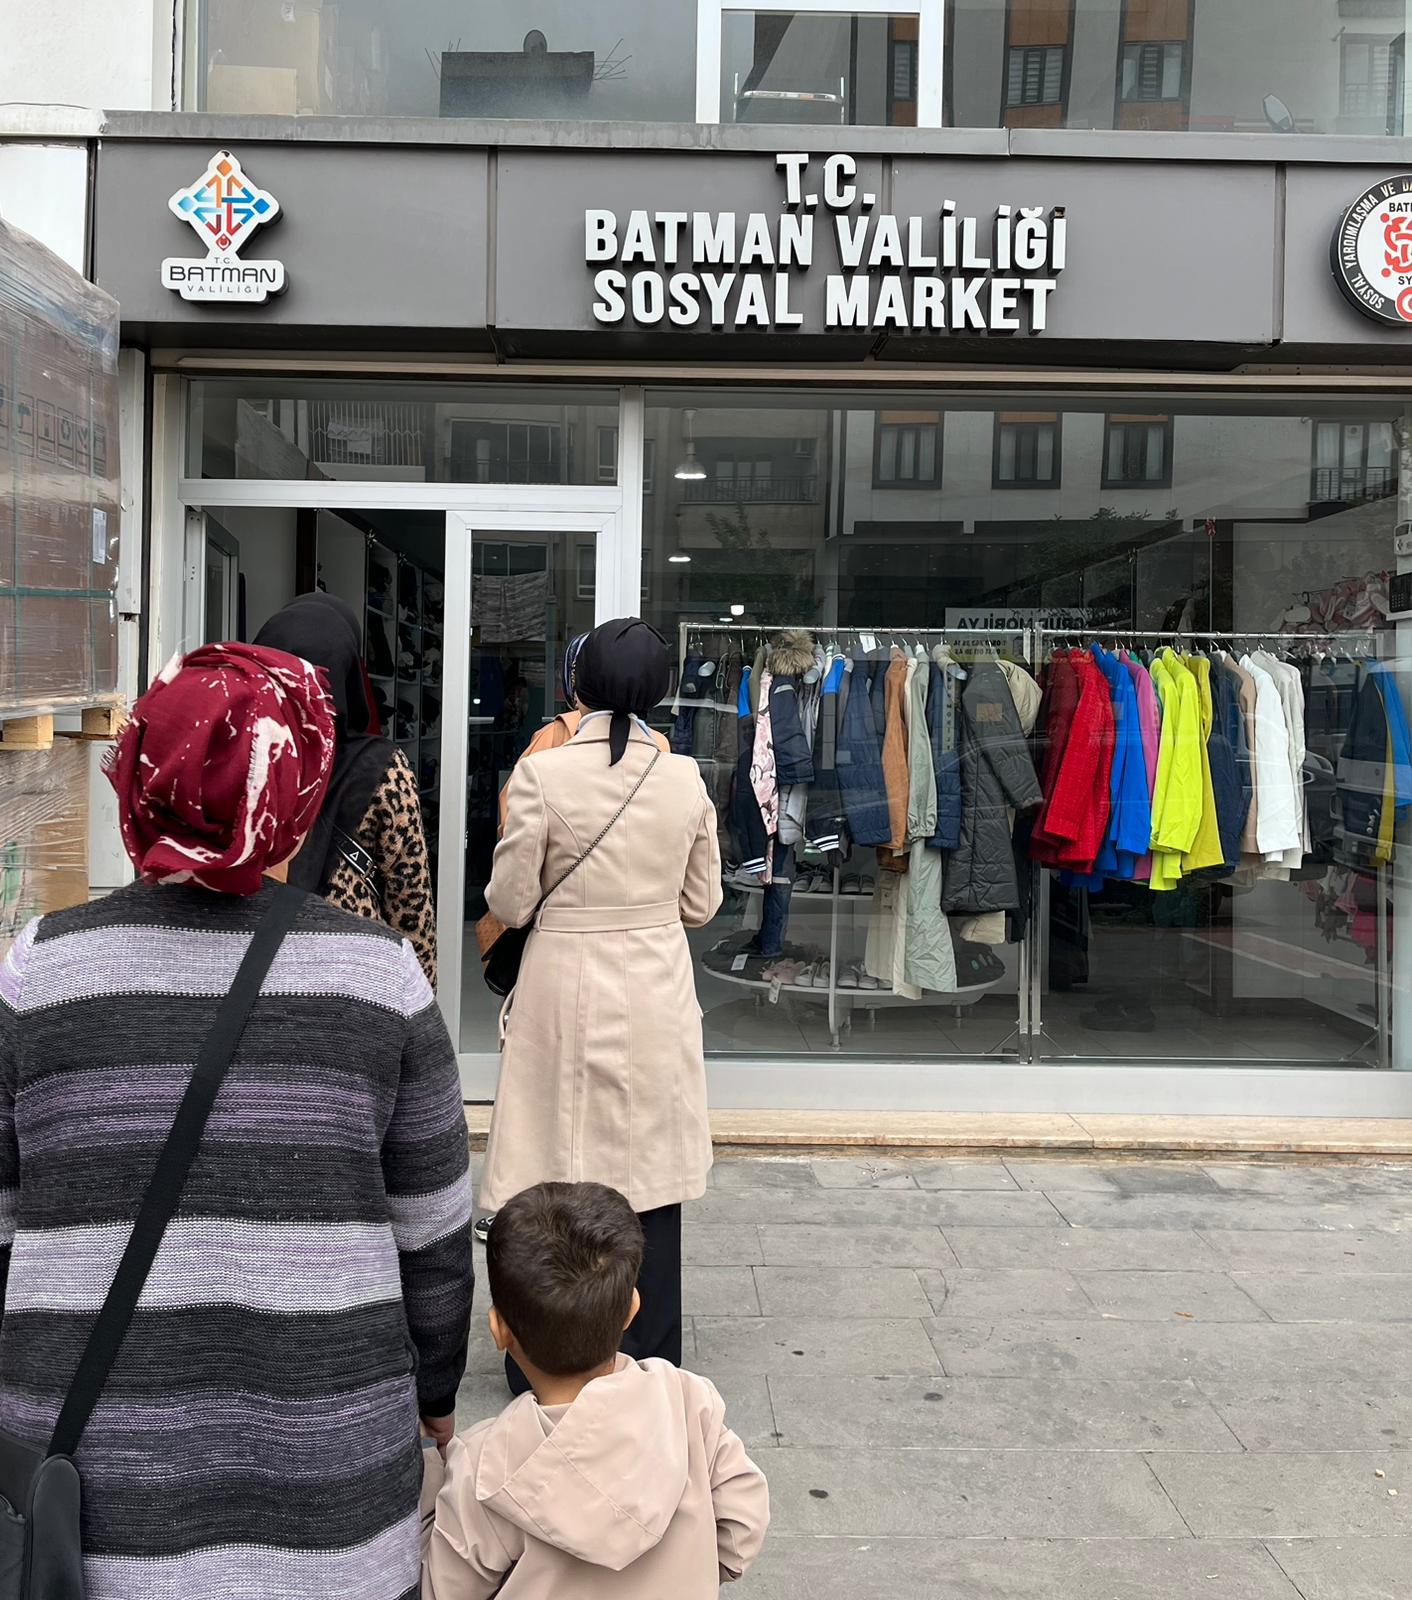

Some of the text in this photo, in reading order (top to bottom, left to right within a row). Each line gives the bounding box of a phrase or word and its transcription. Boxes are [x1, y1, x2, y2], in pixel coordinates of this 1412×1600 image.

[775, 153, 876, 209] T.C.
[1389, 202, 1412, 213] BAT
[214, 257, 233, 265] T.C.
[585, 199, 1067, 270] BATMAN VALİLİĞİ
[1351, 272, 1385, 309] SOSYAL
[1380, 182, 1396, 198] VE
[170, 265, 276, 283] BATMAN
[593, 269, 1057, 332] SOSYAL MARKET
